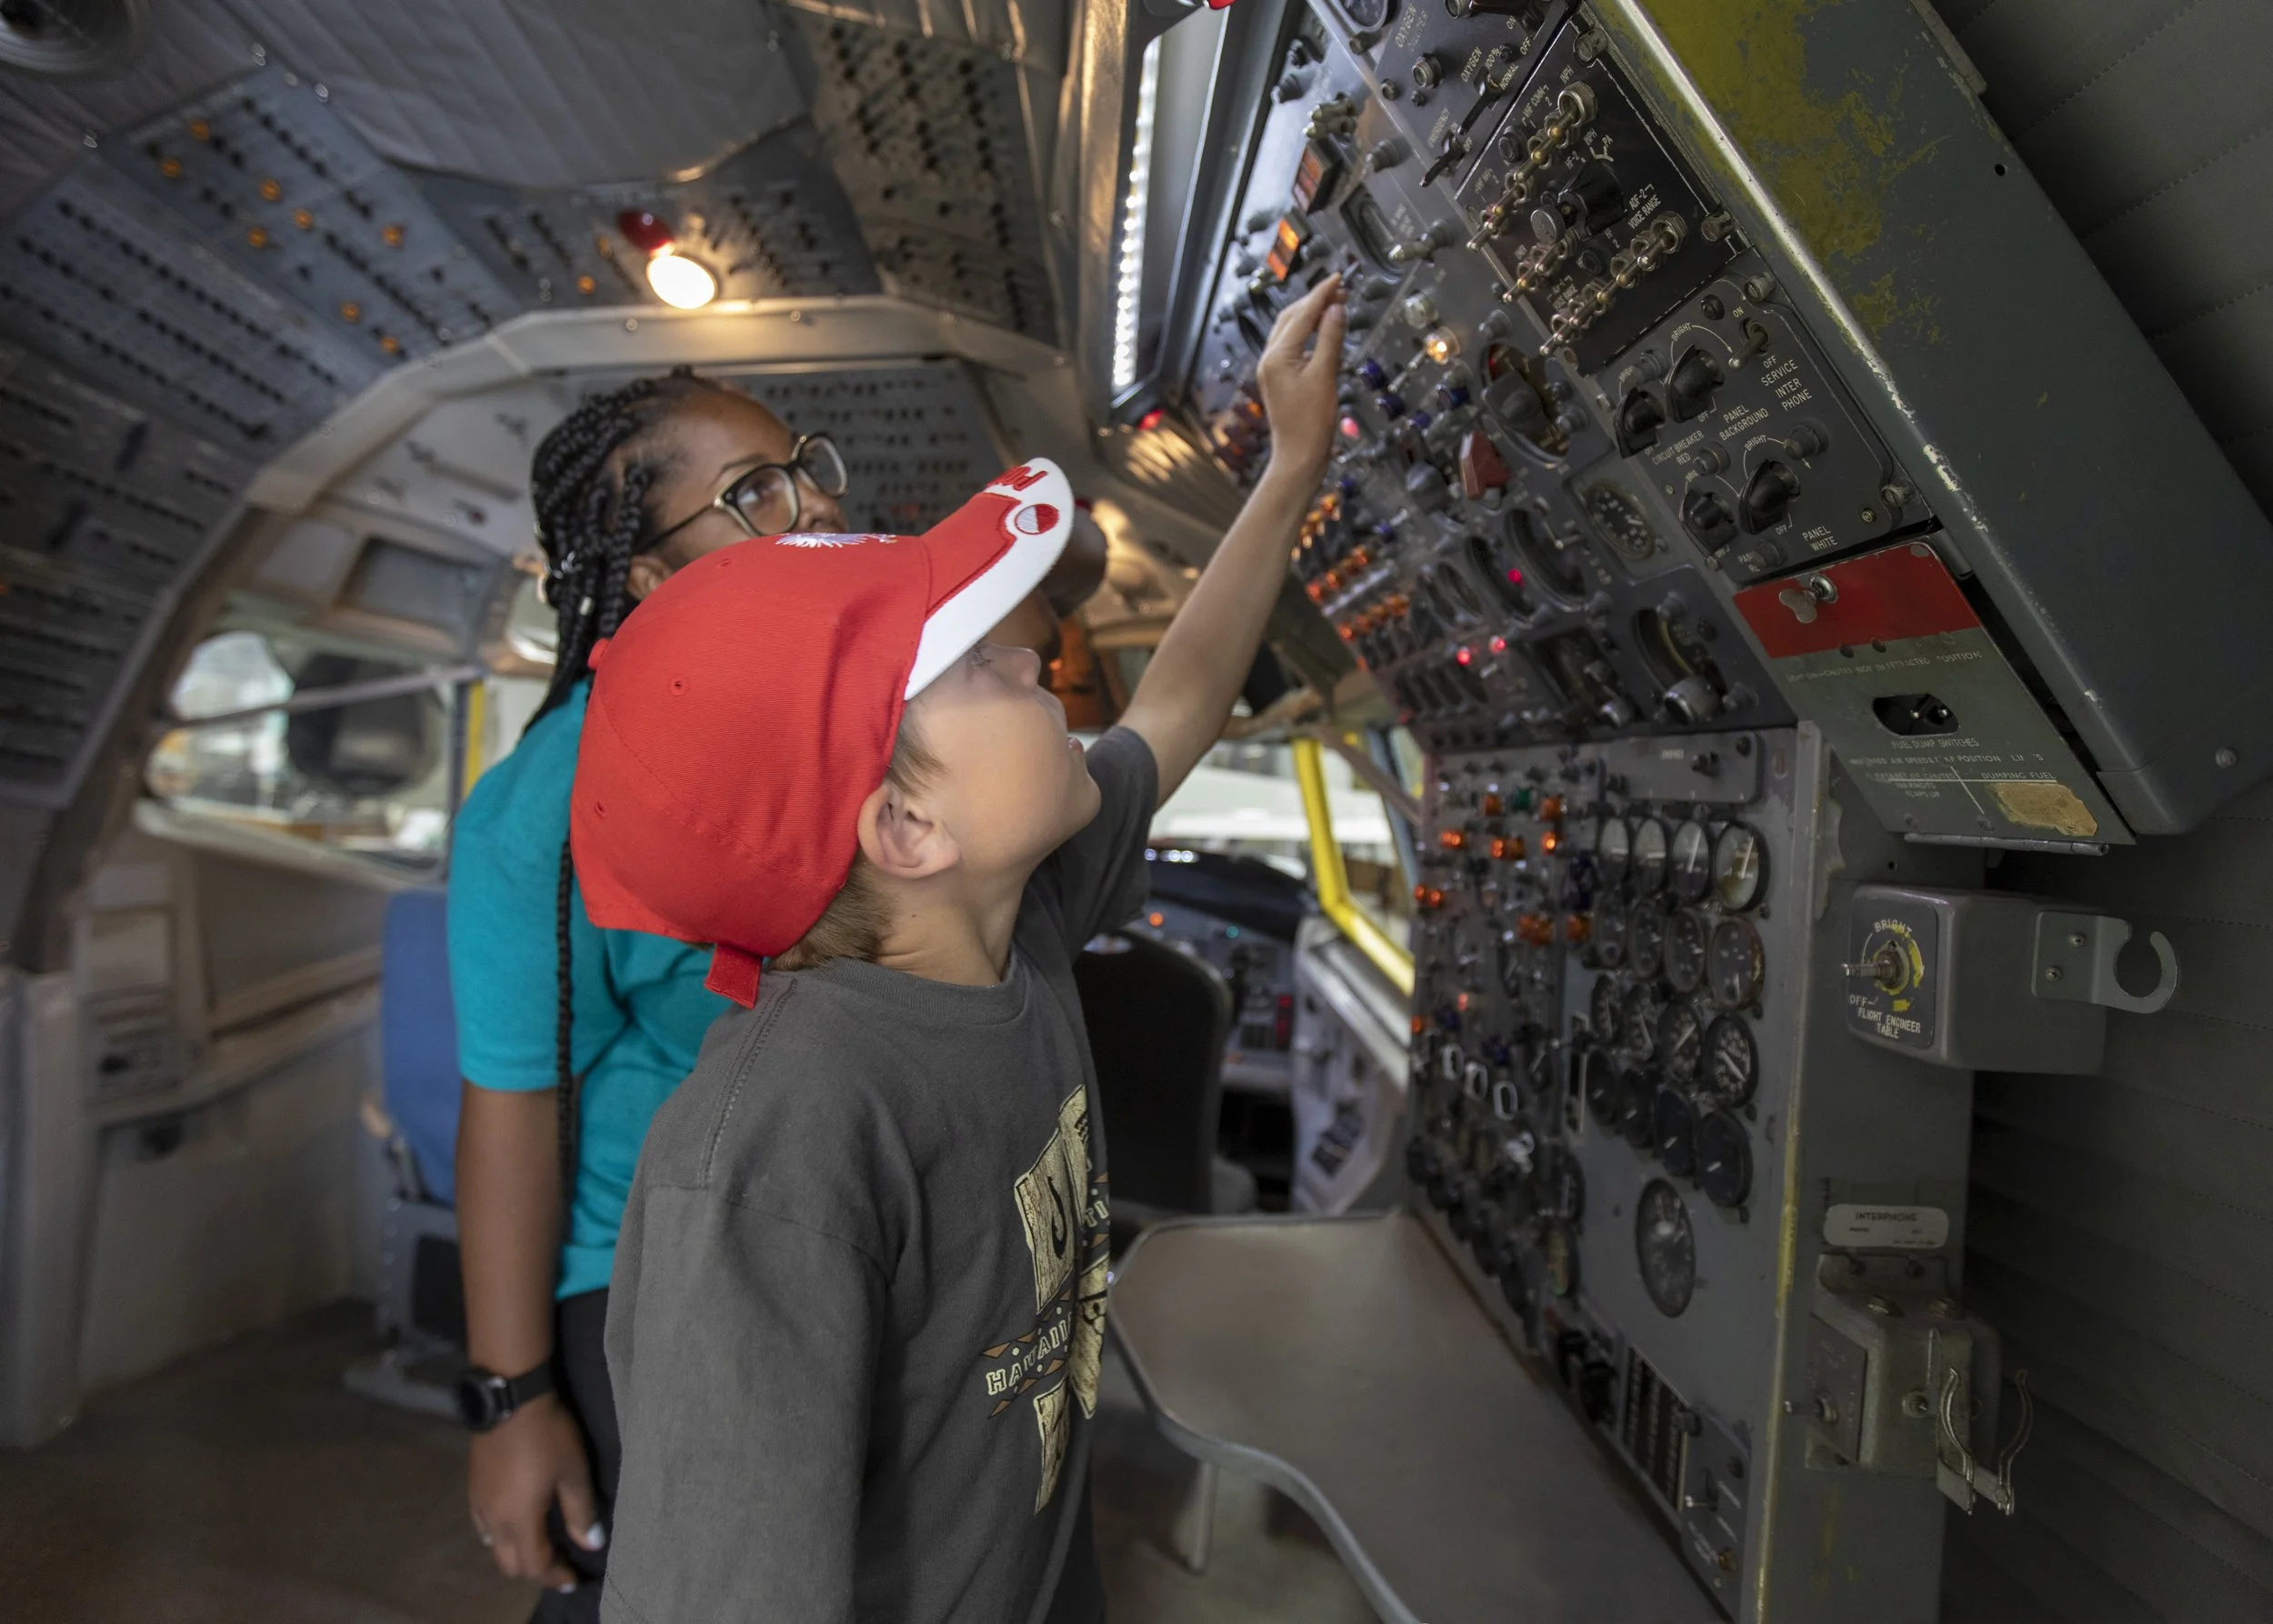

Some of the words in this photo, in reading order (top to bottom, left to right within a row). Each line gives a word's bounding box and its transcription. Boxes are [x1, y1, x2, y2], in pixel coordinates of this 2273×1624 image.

[1395, 3, 1417, 48] OXYGEN
[1507, 15, 1517, 30] ON
[1520, 36, 1531, 55] OFF
[1461, 46, 1482, 82] OXYGEN
[1485, 47, 1501, 69] 100%
[1499, 63, 1519, 91] NORMAL
[1559, 65, 1575, 84] INPH
[1602, 134, 1614, 147] PA
[1565, 150, 1580, 170] HF-2
[1628, 188, 1648, 211] ADF-2
[1627, 211, 1646, 229] VOICE
[1642, 194, 1662, 216] RANGE
[1732, 306, 1745, 318] ON
[1671, 322, 1692, 342] BRIGHT
[1763, 355, 1777, 369] OFF
[1760, 359, 1798, 386] SERVICE
[1775, 377, 1803, 399] INTER
[1781, 388, 1813, 412] PHONE
[1697, 412, 1709, 423] OFF
[1723, 404, 1750, 424] PANEL
[1719, 407, 1768, 442] BACKGROUND
[1652, 445, 1677, 466] CIRCUIT
[1676, 429, 1705, 452] BREAKER
[1745, 435, 1767, 452] BRIGHT
[1676, 451, 1692, 466] RED
[1776, 525, 1788, 536] OFF
[1802, 526, 1832, 542] PANEL
[1809, 536, 1838, 553] WHITE
[1891, 740, 1912, 750] FUEL
[1912, 739, 1935, 749] DUMP
[1939, 737, 1980, 748] SWITCHES
[1957, 754, 2002, 764] POSITION
[1981, 771, 2027, 779] DUMPING
[2029, 771, 2057, 780] FUEL
[1874, 918, 1912, 937] BRIGHT
[1849, 995, 1868, 1006] OFF
[1857, 1007, 1883, 1021] FLIGHT
[1886, 1014, 1921, 1034] ENGINEER
[1877, 1023, 1899, 1039] TABLE
[1855, 1211, 1918, 1222] INTERPHONE
